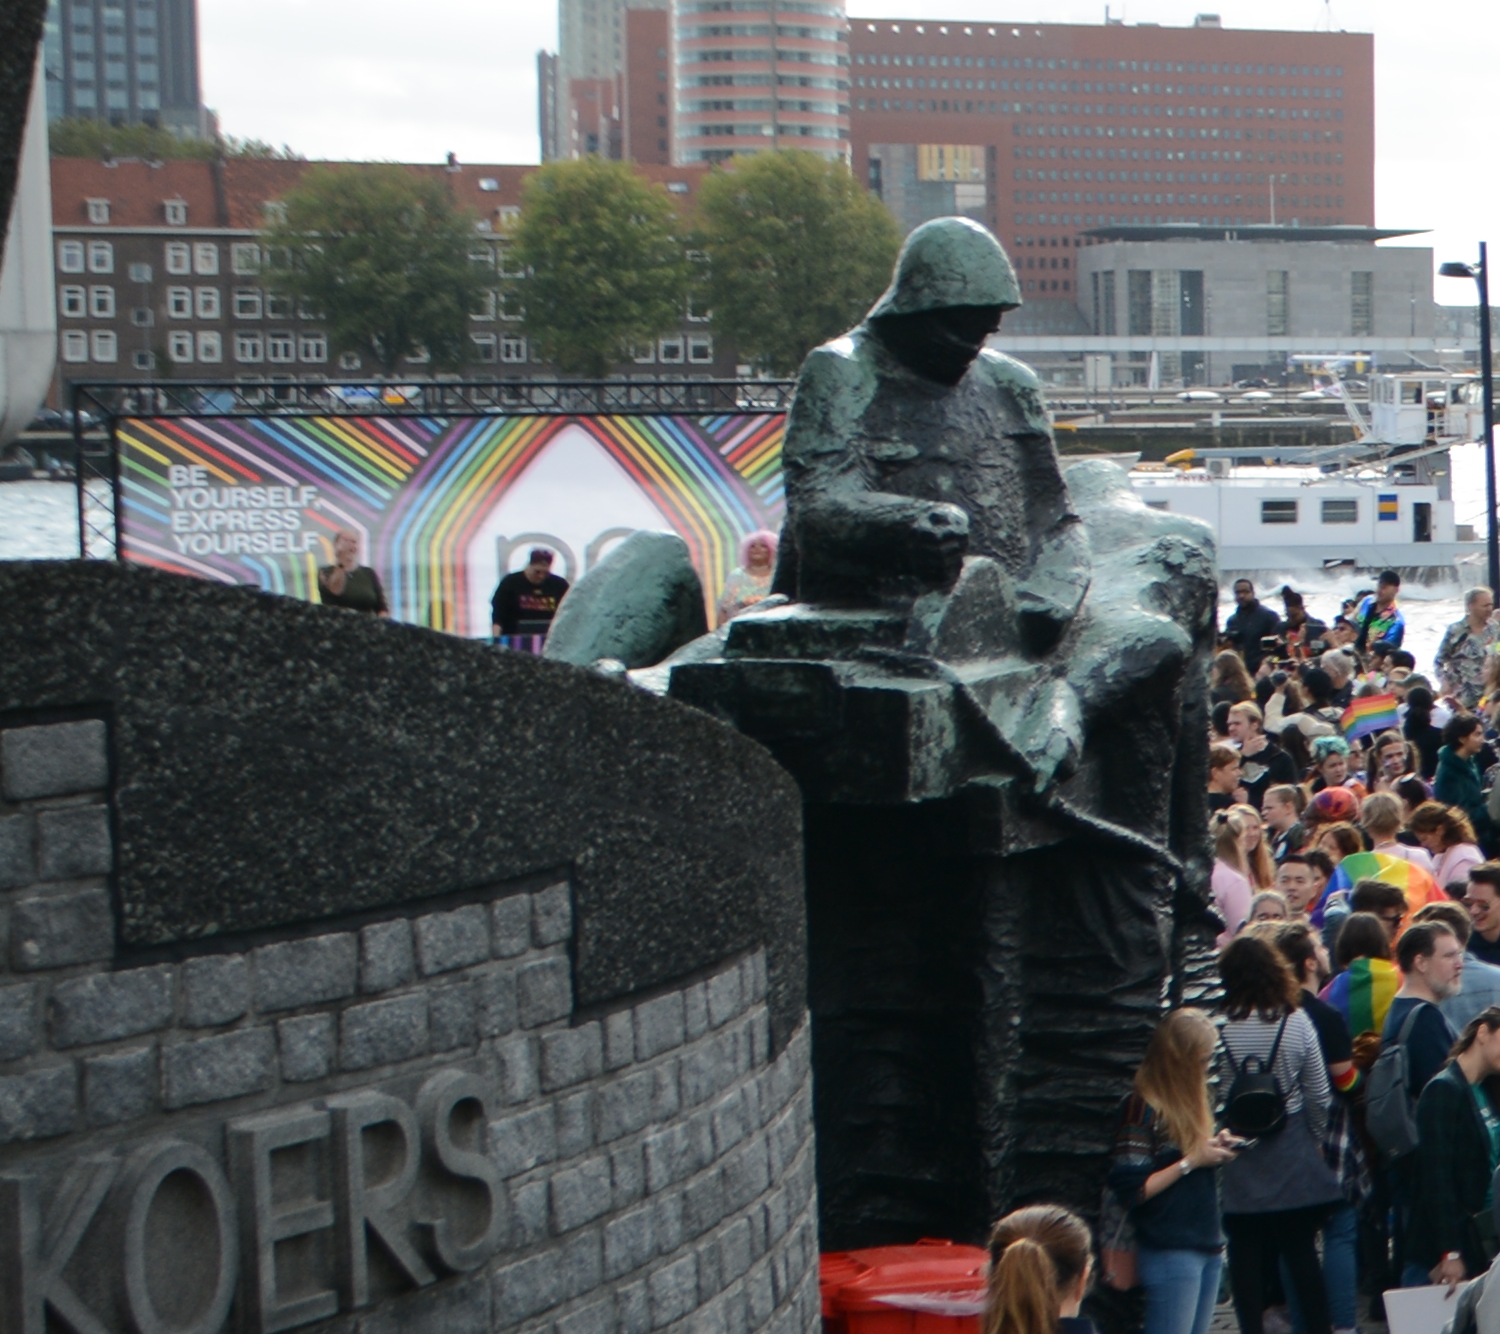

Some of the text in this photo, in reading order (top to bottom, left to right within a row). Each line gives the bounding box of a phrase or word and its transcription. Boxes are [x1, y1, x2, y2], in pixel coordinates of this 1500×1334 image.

[169, 464, 209, 487] BE
[170, 485, 321, 510] YOURSELF,
[171, 509, 302, 533] EXPRESS
[171, 531, 320, 556] YOURSELF
